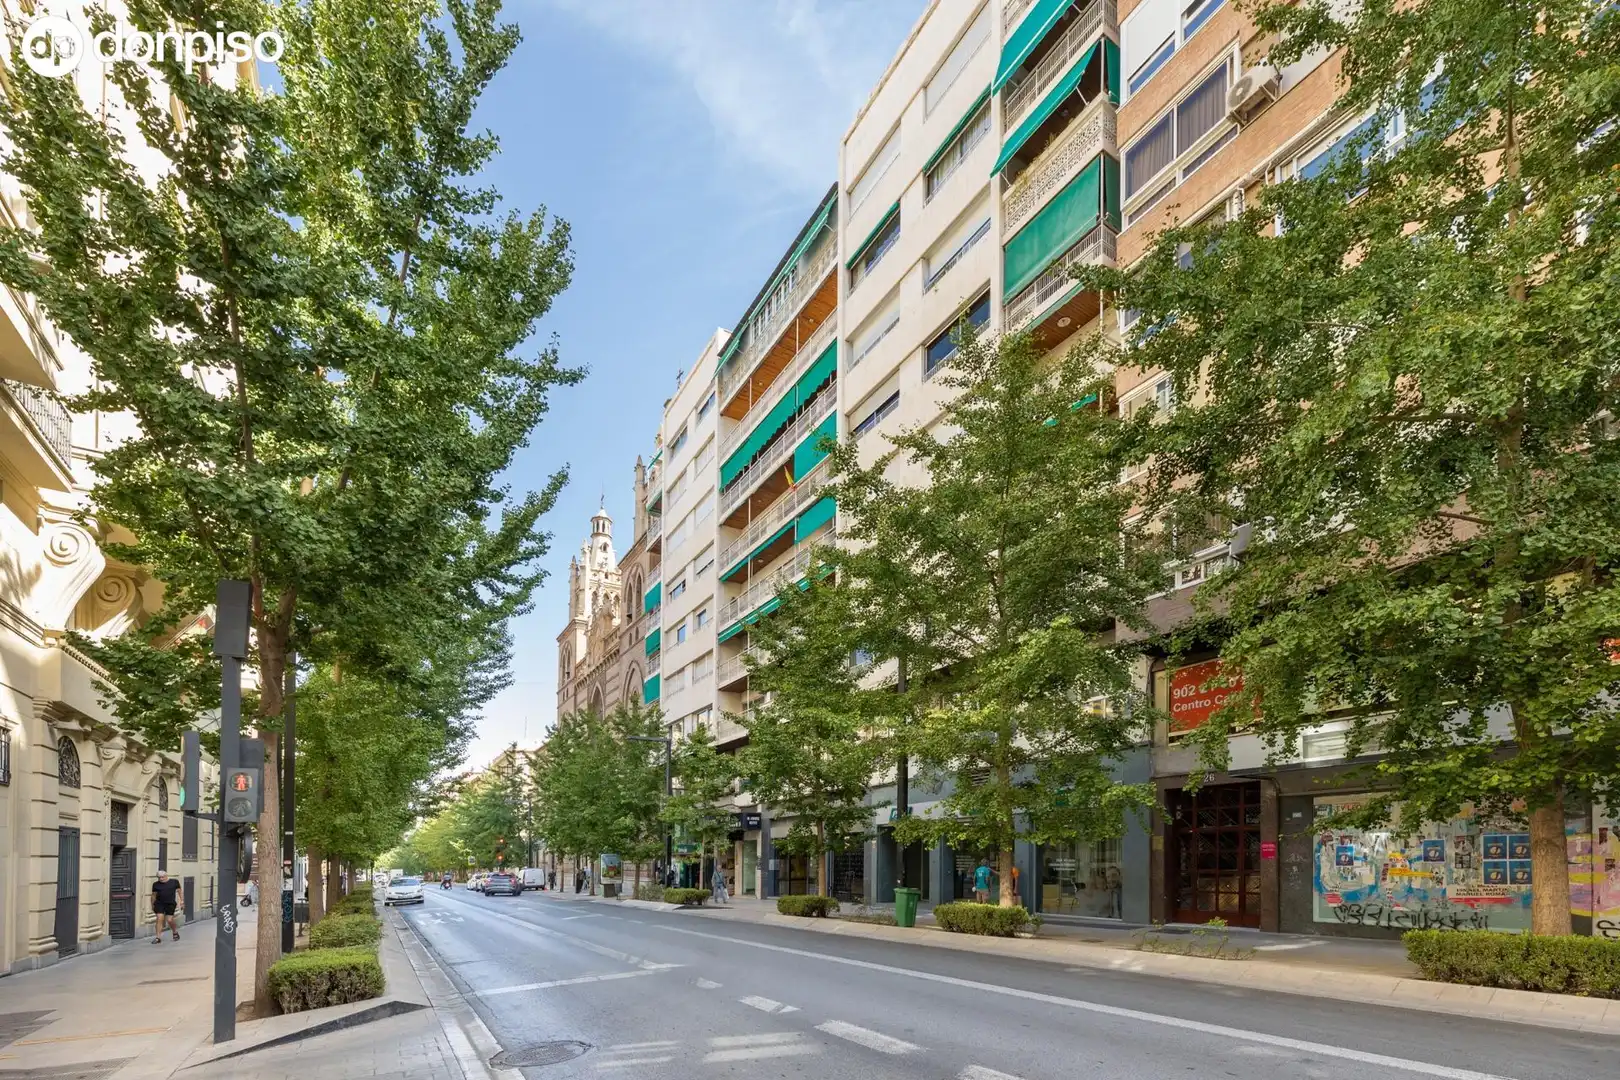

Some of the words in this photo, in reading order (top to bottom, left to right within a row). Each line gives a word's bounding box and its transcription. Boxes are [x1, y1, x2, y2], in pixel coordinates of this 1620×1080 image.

[1173, 685, 1196, 699] 902
[1173, 699, 1211, 712] Centro
[1204, 773, 1215, 783] 26
